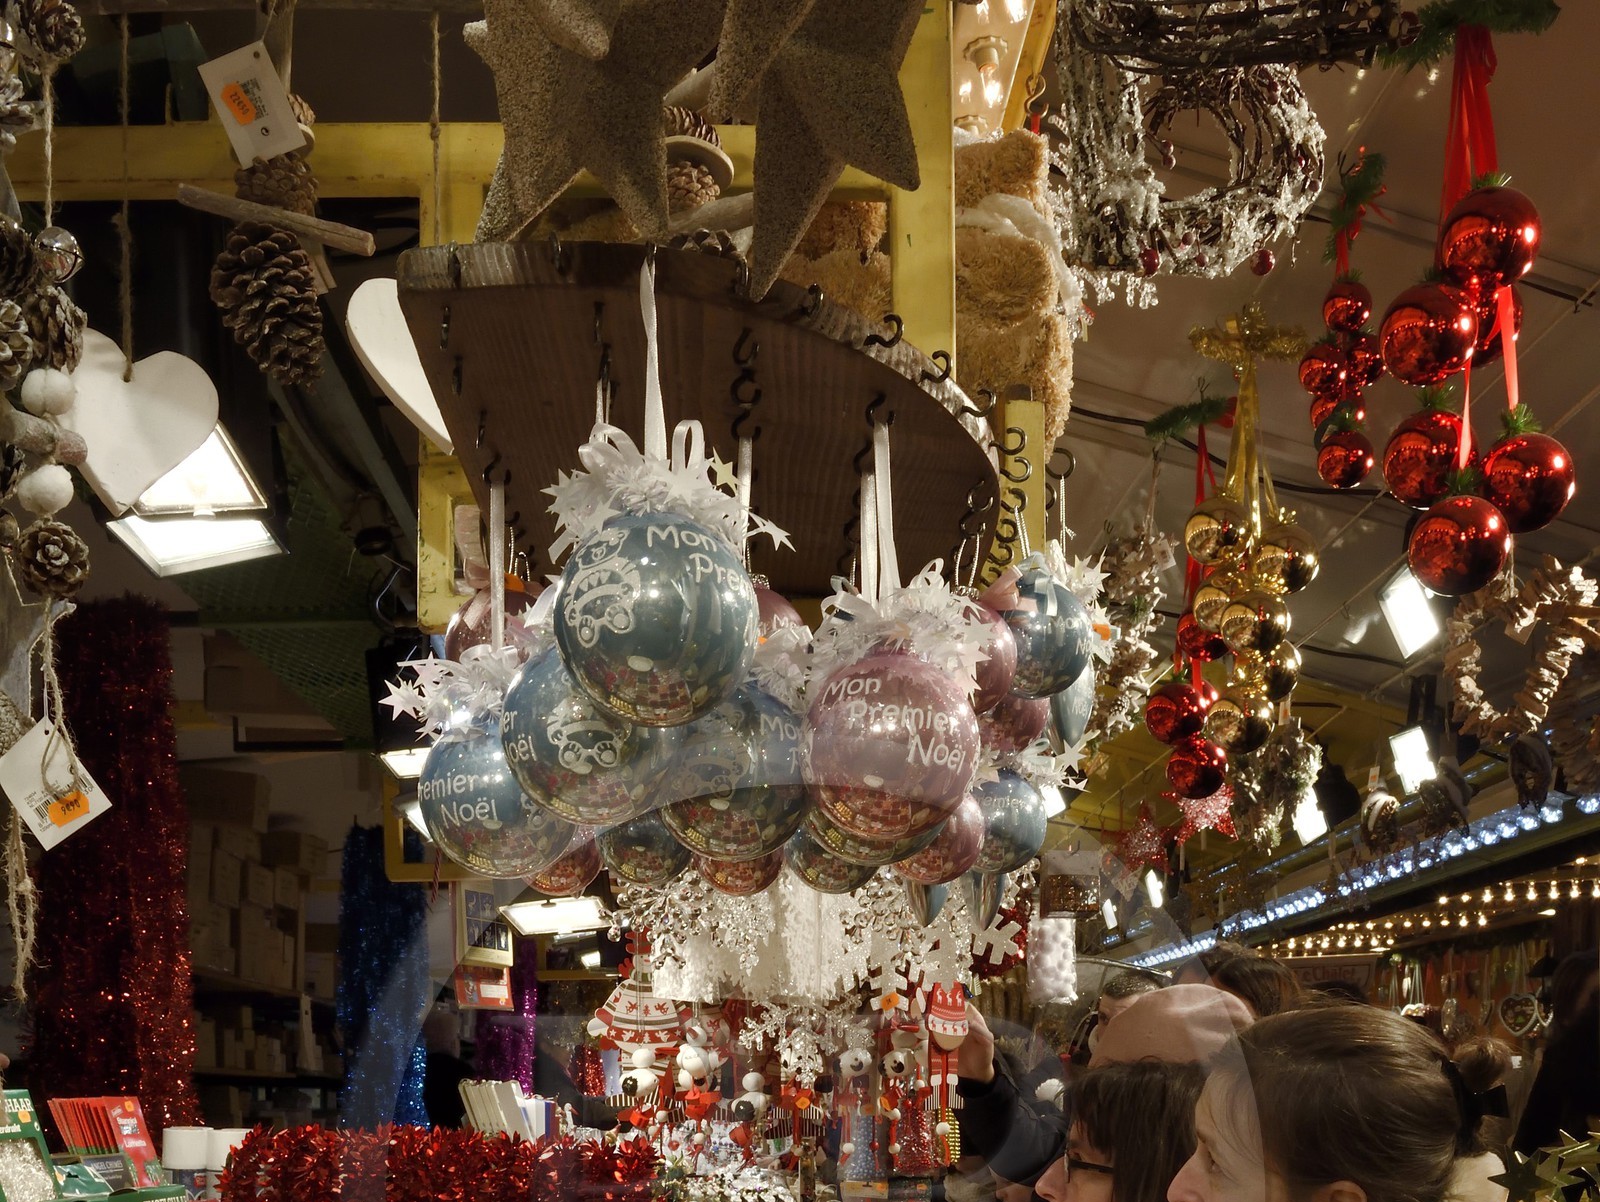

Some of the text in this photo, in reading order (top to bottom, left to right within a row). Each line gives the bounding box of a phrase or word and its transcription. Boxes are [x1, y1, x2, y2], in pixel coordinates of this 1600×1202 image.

[647, 526, 718, 552] Mon
[822, 677, 882, 706] Mon
[849, 700, 955, 735] Premier
[908, 734, 967, 776] Noël
[441, 797, 498, 828] Noël
